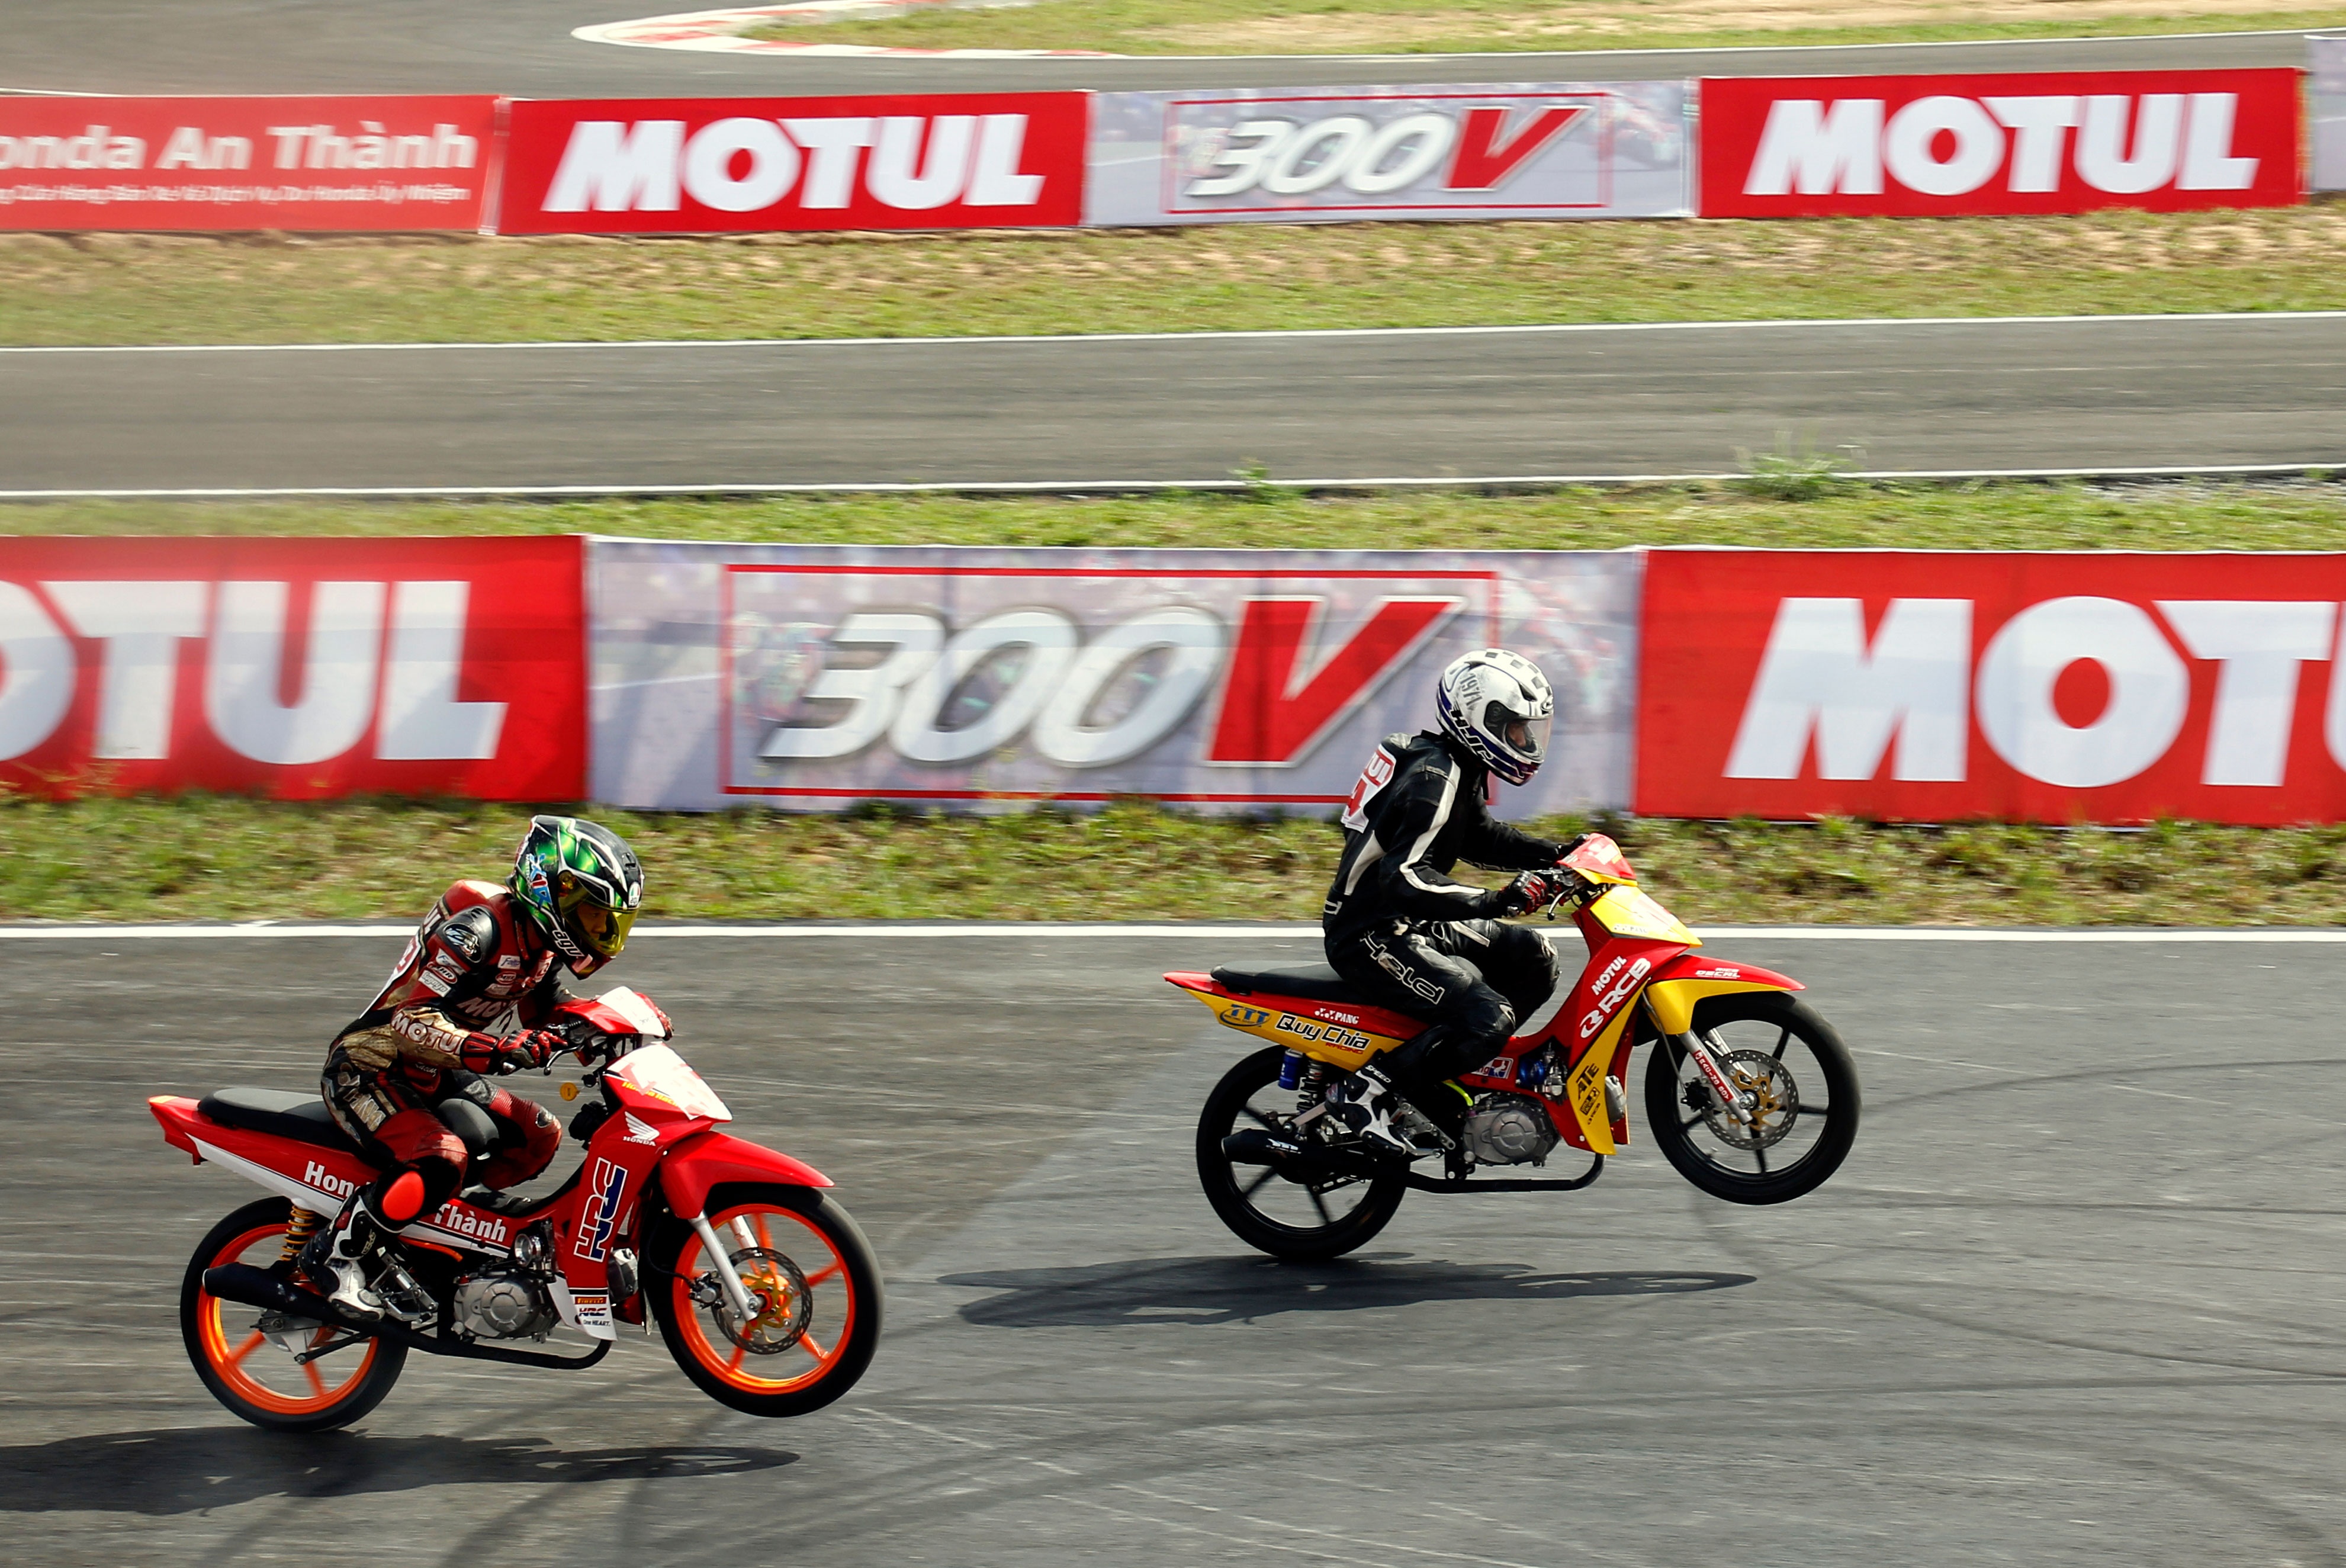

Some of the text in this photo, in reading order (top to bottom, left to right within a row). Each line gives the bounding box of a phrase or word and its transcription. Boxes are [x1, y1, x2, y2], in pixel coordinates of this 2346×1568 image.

[153, 126, 253, 170] An
[265, 120, 478, 169] Thành
[541, 114, 1046, 212] MOTUL
[1184, 105, 1593, 197] 300V
[1742, 92, 2260, 195] MOTUL
[760, 594, 1467, 769] 300V
[1460, 673, 1483, 706] 1971
[1722, 595, 2346, 788] MOT
[1591, 956, 1627, 995] MOTUL
[1598, 957, 1651, 1014] RCB
[1275, 1013, 1371, 1050] Quy Chia
[1325, 1042, 1364, 1055] RACING
[1699, 1058, 1729, 1100] RACING BOY
[622, 1136, 656, 1146] HONDA
